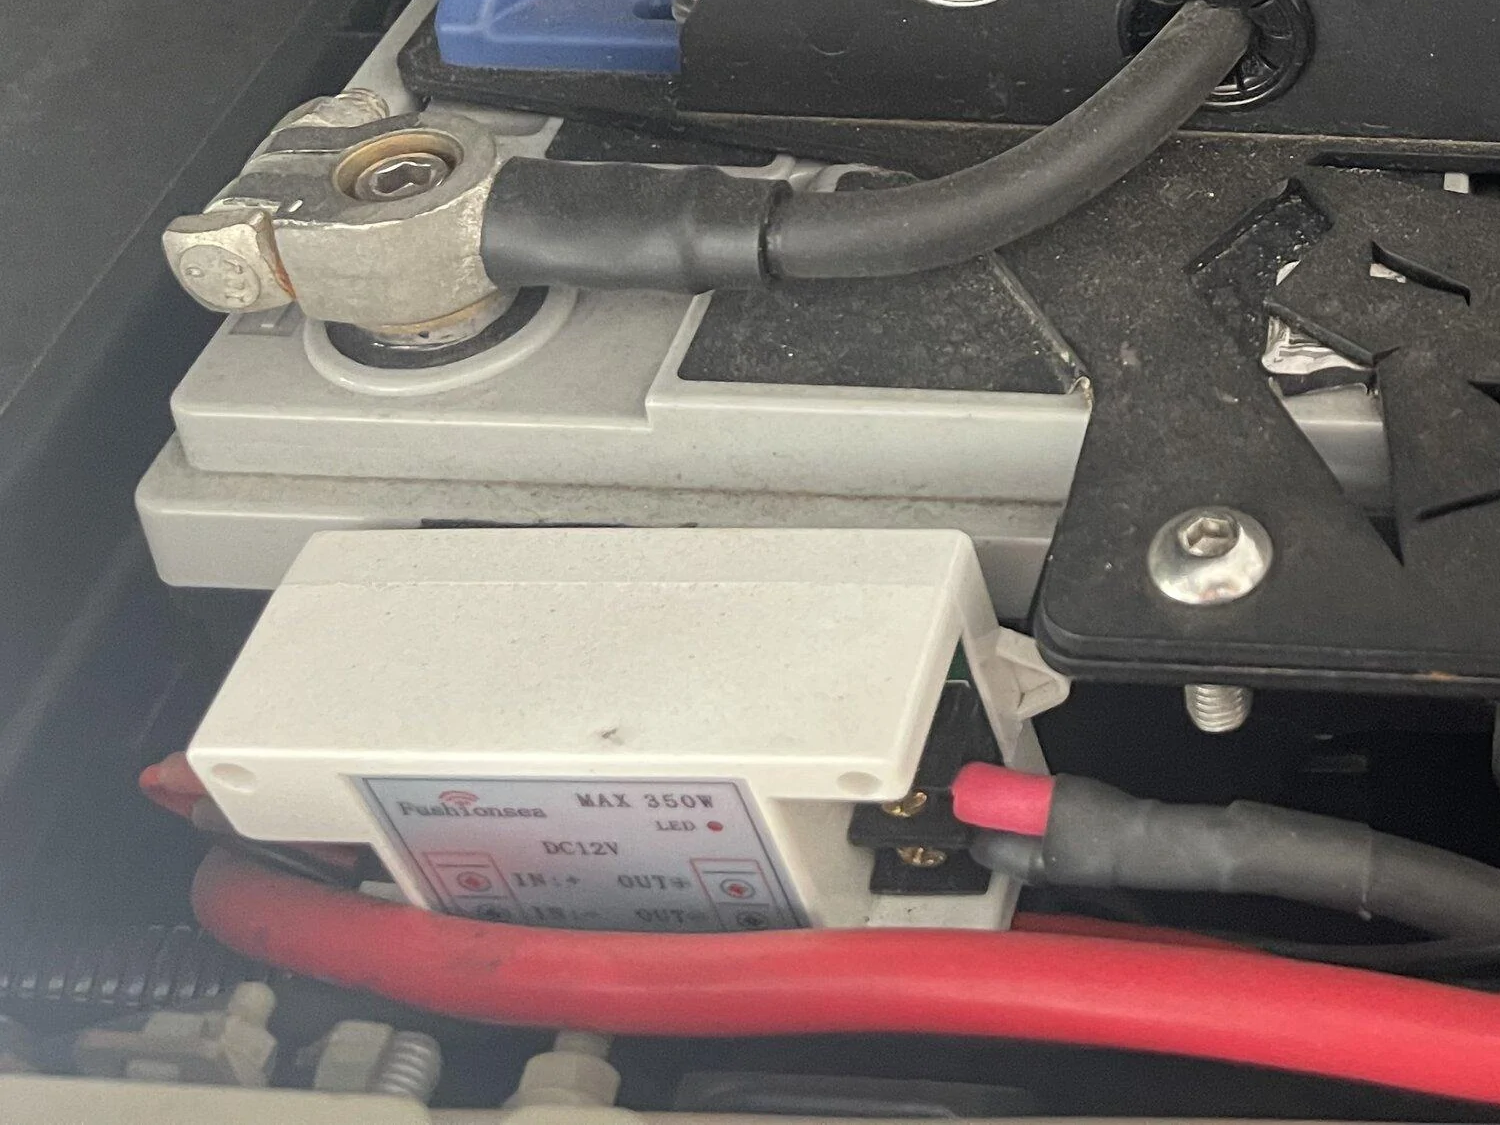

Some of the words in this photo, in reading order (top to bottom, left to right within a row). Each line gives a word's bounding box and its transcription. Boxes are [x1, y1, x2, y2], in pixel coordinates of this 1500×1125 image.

[575, 793, 631, 808] MAX
[643, 793, 714, 809] 350W
[655, 820, 697, 832] LED
[541, 840, 620, 856] DC12V
